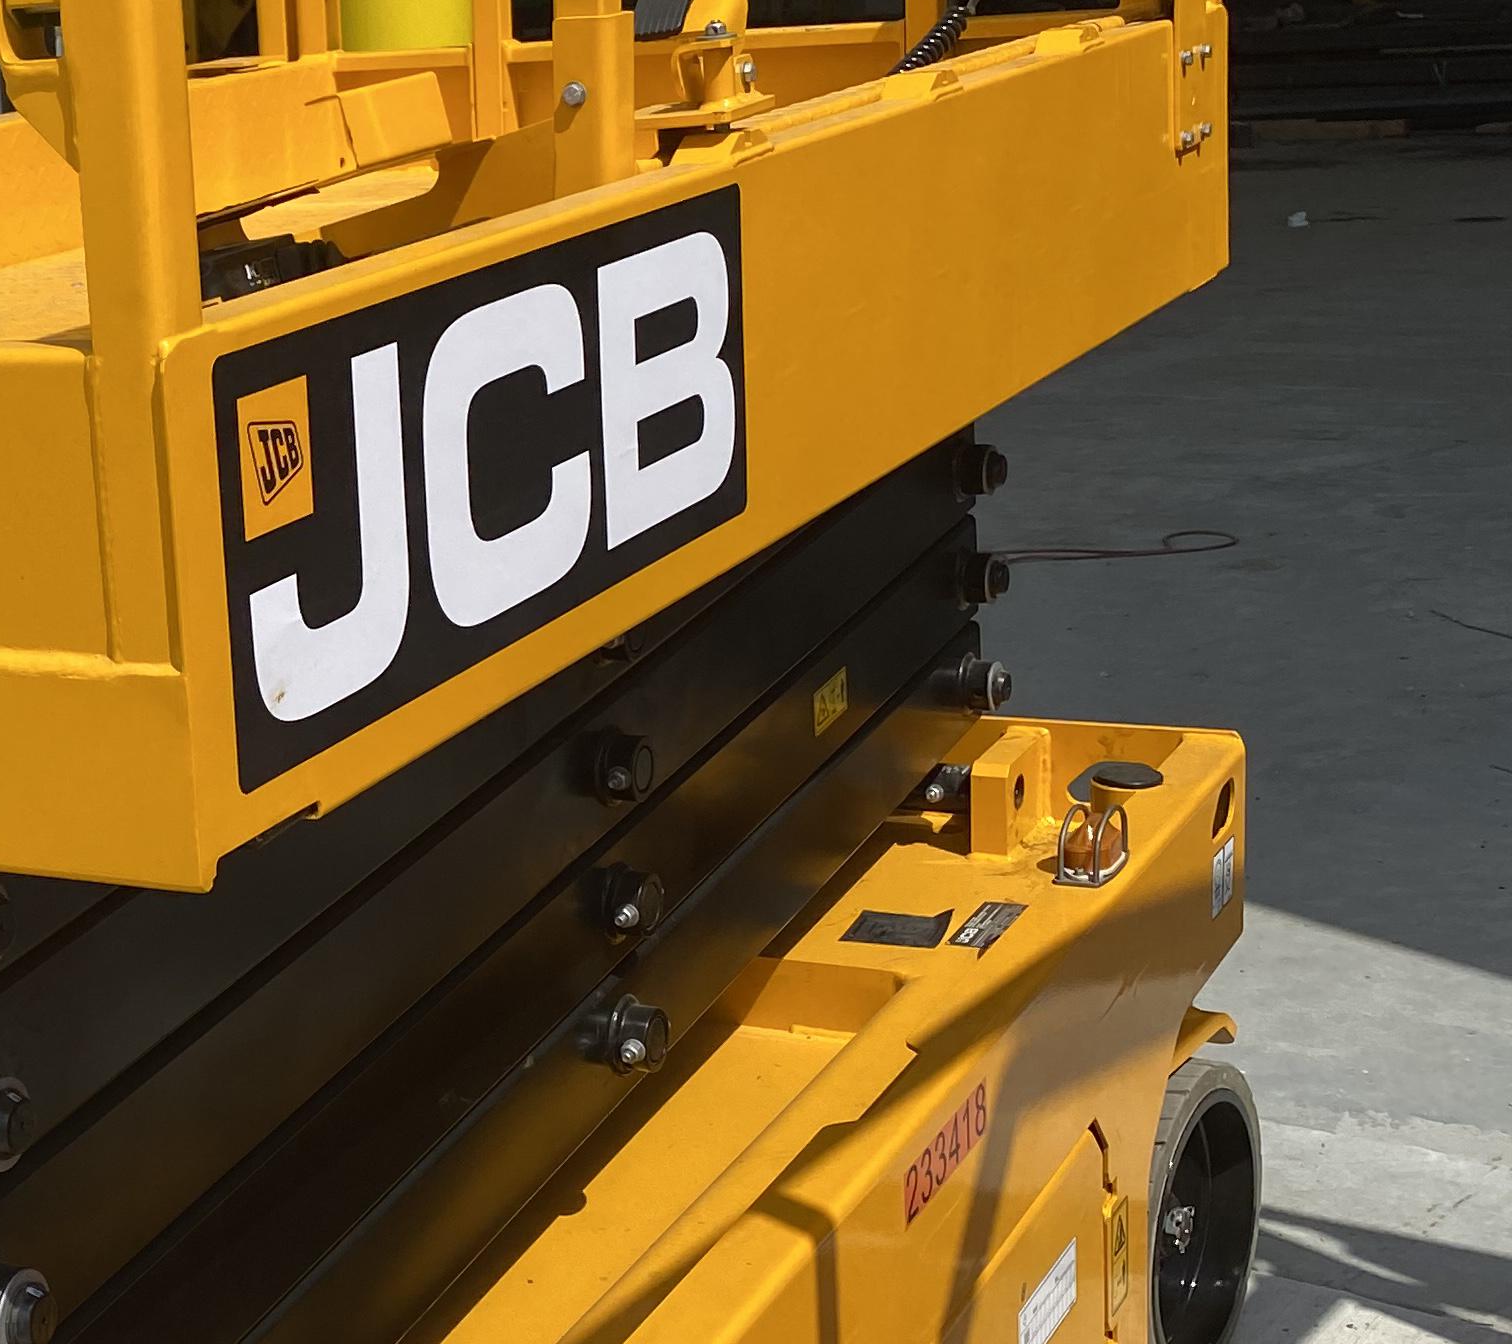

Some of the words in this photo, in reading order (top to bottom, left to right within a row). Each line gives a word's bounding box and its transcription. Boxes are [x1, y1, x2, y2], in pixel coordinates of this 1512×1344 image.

[250, 232, 735, 722] JCB
[257, 427, 299, 494] JCB
[906, 1083, 987, 1224] 233418
